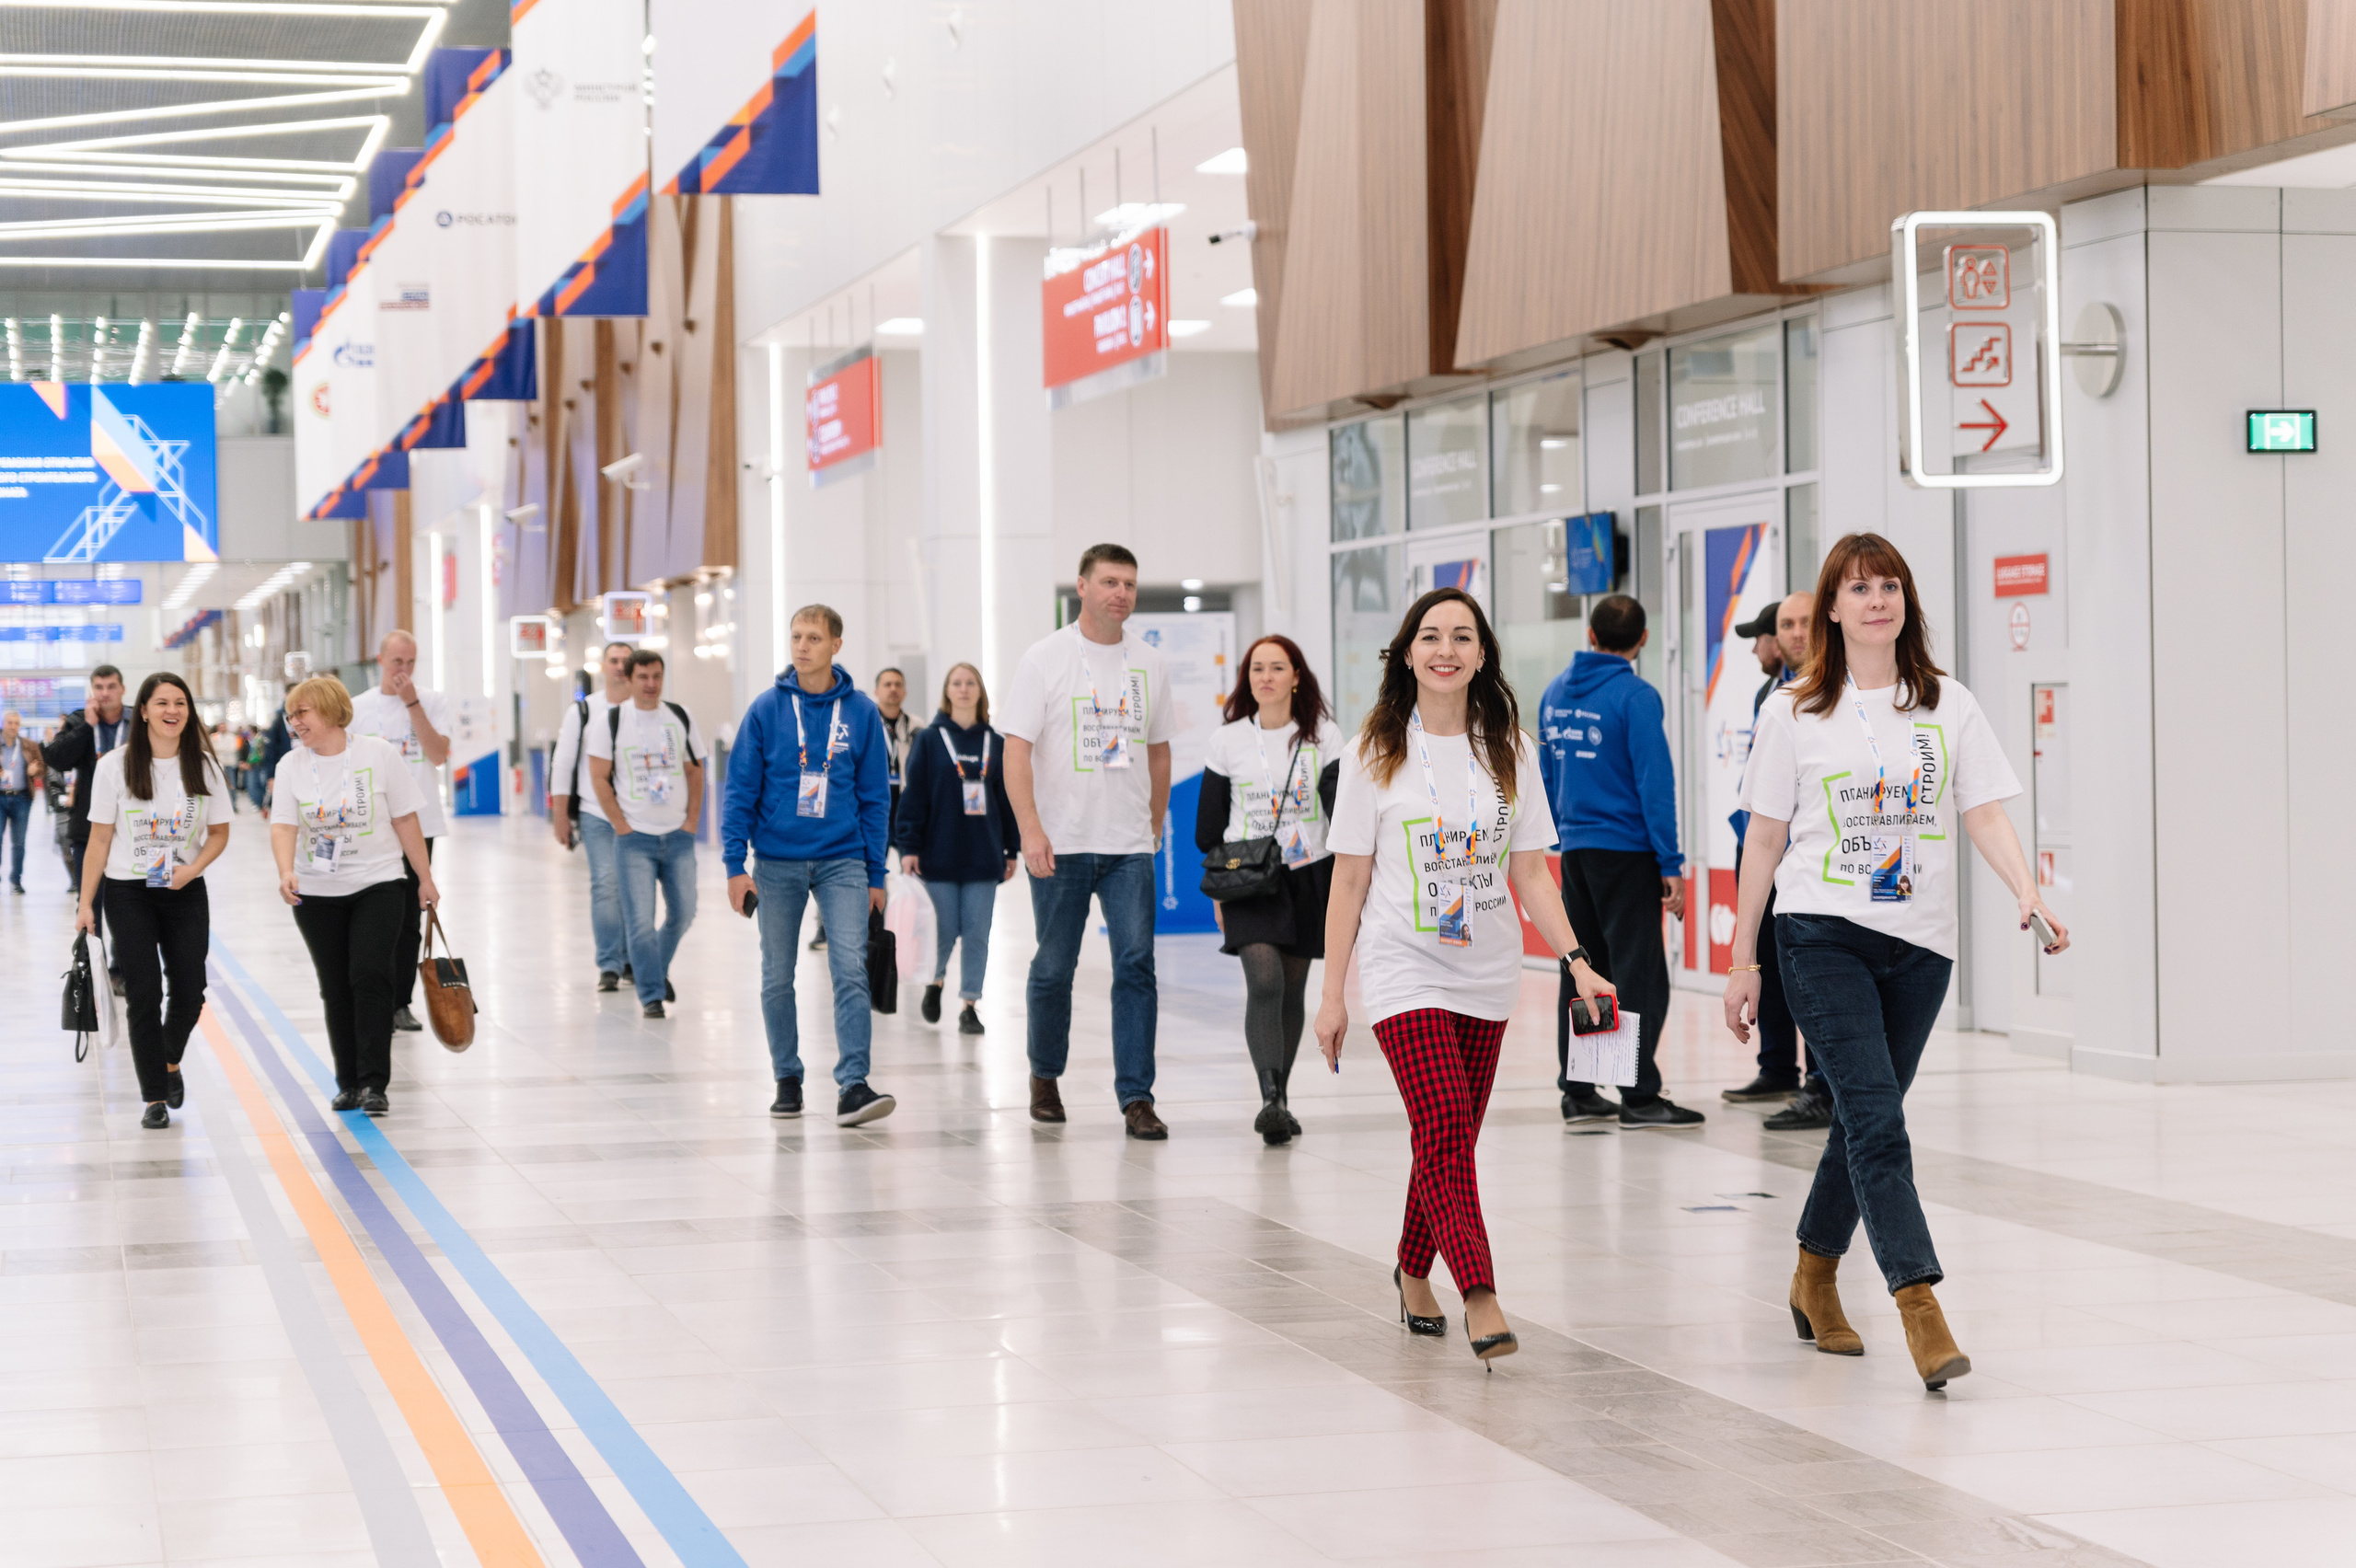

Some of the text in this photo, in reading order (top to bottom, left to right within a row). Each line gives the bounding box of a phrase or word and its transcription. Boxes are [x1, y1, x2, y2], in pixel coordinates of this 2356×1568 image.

[1916, 733, 1936, 804] СТРОИМ!
[1840, 863, 1854, 874] ПО
[1475, 894, 1507, 912] РОССИИ
